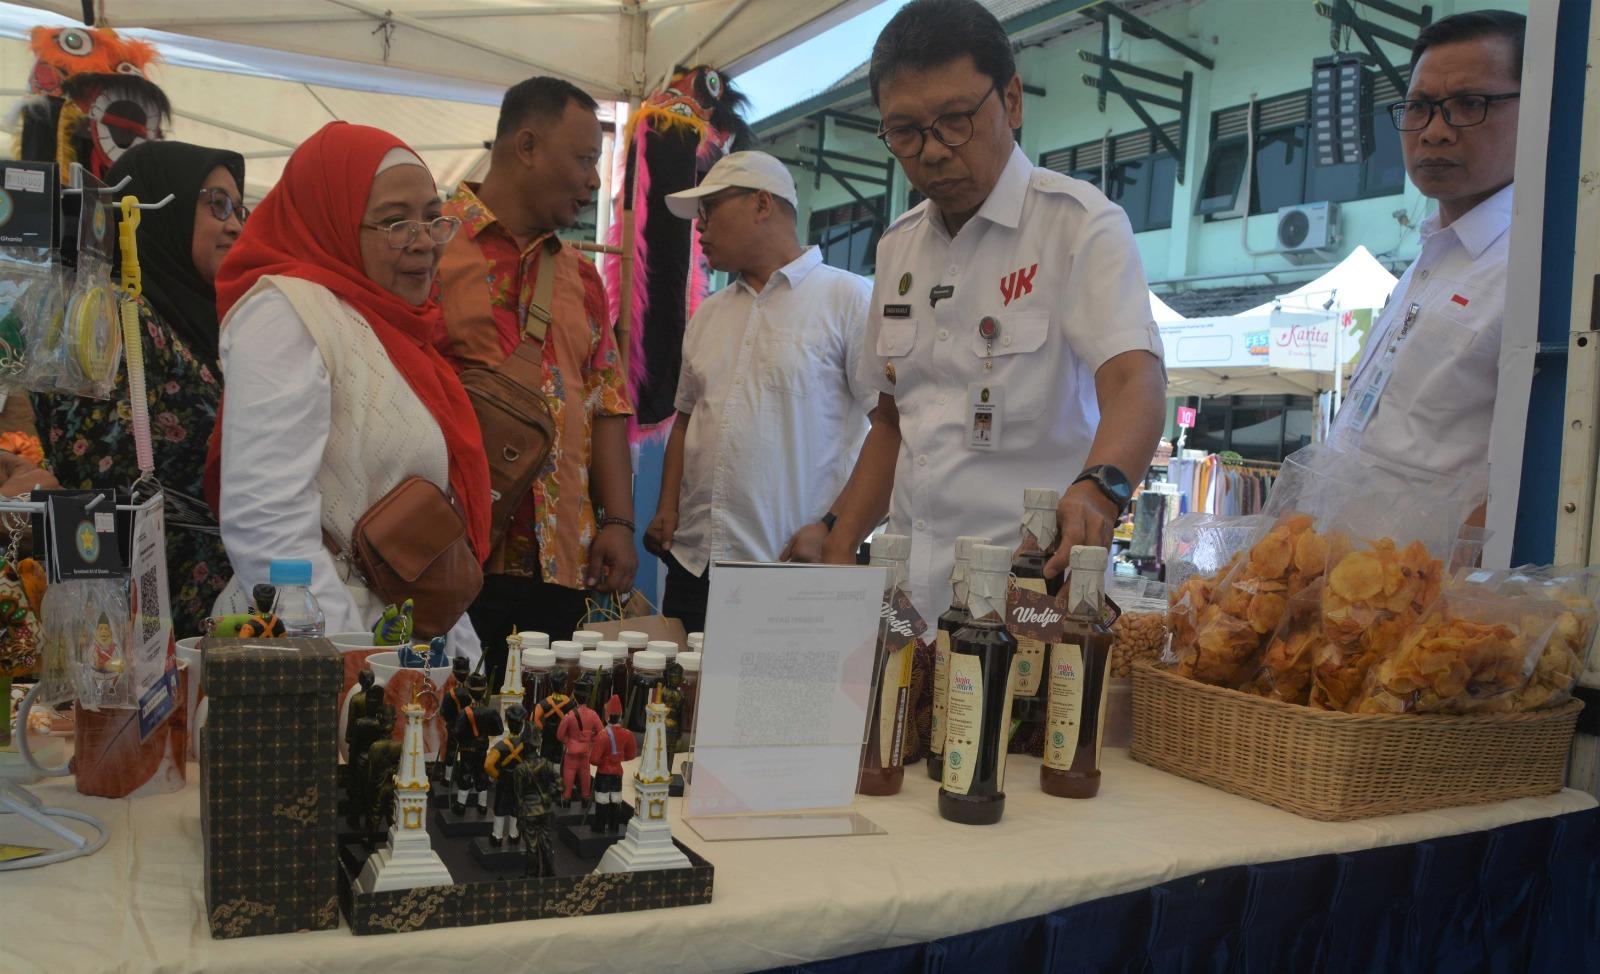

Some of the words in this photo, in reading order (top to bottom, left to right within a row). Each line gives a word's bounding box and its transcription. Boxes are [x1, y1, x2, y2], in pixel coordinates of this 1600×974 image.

[1000, 263, 1038, 307] YK
[1247, 335, 1269, 347] FES
[1276, 324, 1329, 347] Karita
[1012, 606, 1062, 628] Wedja
